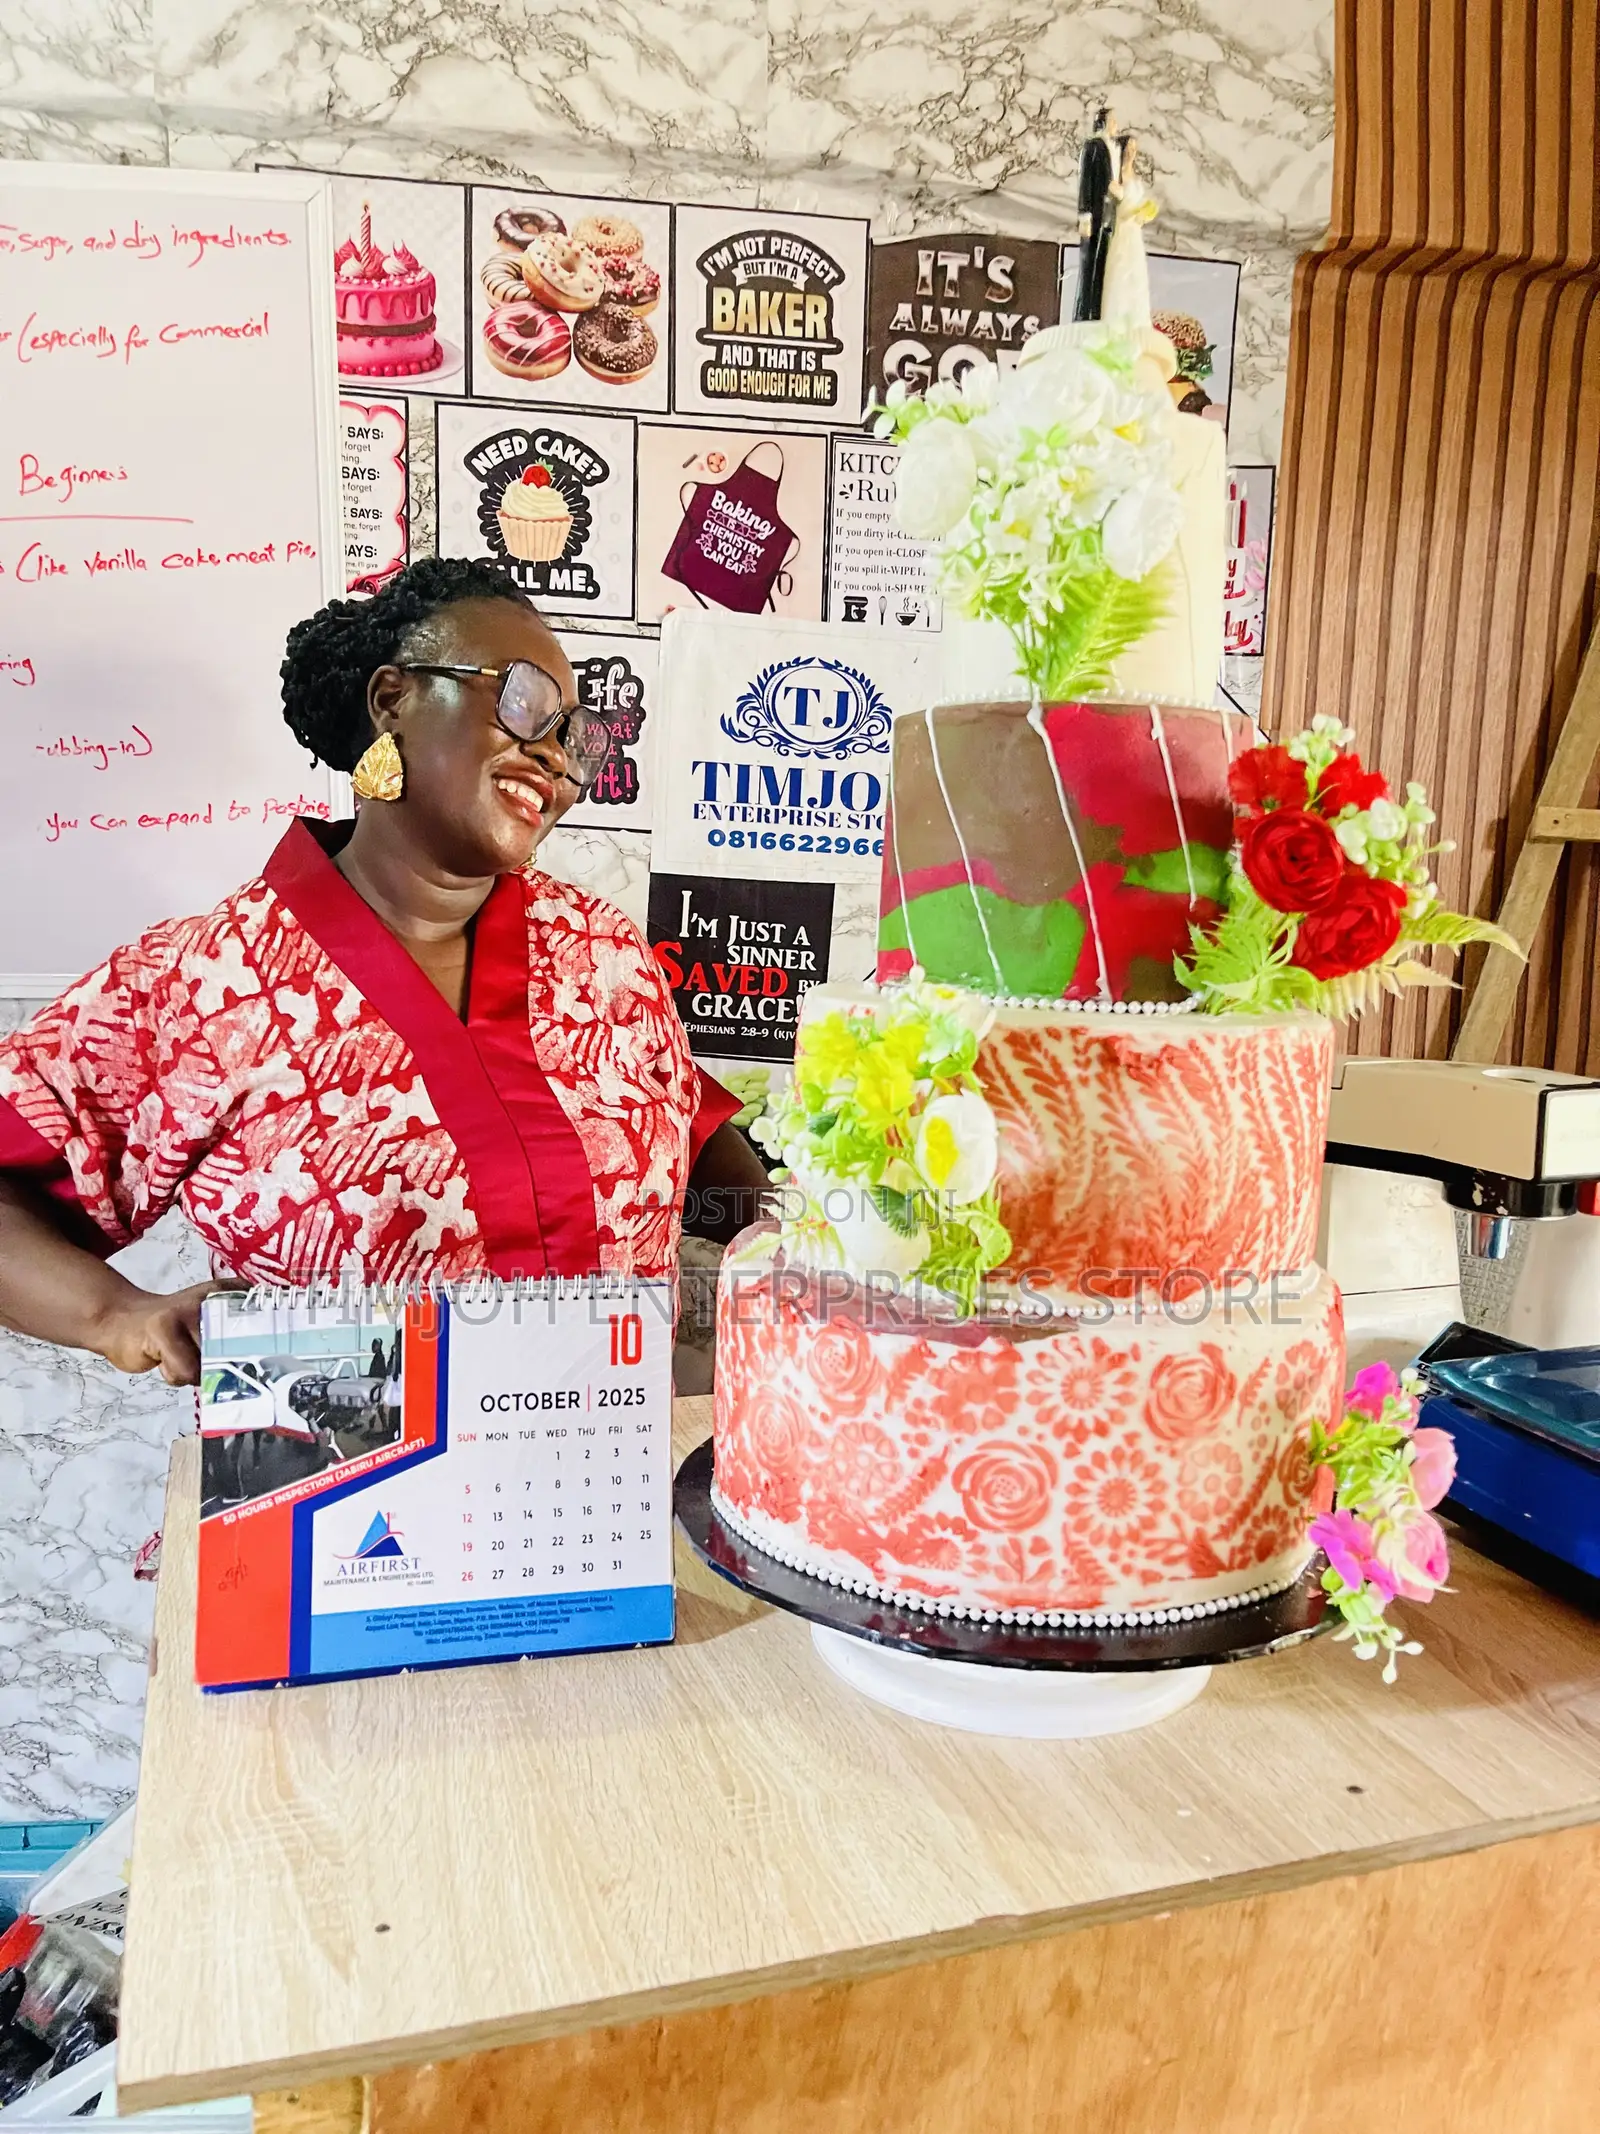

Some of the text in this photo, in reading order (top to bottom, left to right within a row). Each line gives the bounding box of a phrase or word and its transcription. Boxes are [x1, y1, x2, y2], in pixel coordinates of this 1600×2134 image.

[703, 236, 840, 285] I'M NOT PERFECT
[743, 261, 799, 281] BUT I'M A
[915, 245, 1016, 304] IT'S
[712, 286, 828, 340] BAKER
[888, 302, 1041, 342] ALWAYS
[124, 324, 150, 365] for
[721, 344, 817, 372] AND THAT IS
[706, 367, 832, 400] GOOD ENOUGH FOR ME
[347, 426, 384, 440] SAYS:
[470, 434, 603, 481] NEED CAKE?
[341, 465, 381, 481] SAYS:
[350, 507, 383, 520] SAYS:
[710, 489, 777, 541] Baking
[727, 520, 737, 531] IS
[835, 507, 892, 523] If you empty
[702, 519, 766, 559] CHEMISTRY
[835, 526, 844, 536] If
[845, 528, 862, 540] you
[863, 527, 885, 541] dirty
[703, 547, 746, 575] CAN EAT
[716, 540, 743, 562] YOU
[834, 544, 843, 554] If
[845, 546, 861, 558] you
[863, 548, 884, 558] open
[548, 567, 595, 594] ME.
[833, 562, 842, 572] If
[844, 564, 860, 575] you
[862, 564, 880, 576] spill
[833, 580, 841, 590] If
[844, 581, 860, 593] you
[861, 582, 882, 592] cook
[783, 686, 853, 729] TJ
[692, 803, 842, 829] ENTERPRISE
[792, 925, 811, 946] A
[726, 944, 818, 972] SINNER
[691, 992, 804, 1025] GRACE!
[608, 1313, 644, 1367] 10
[480, 1387, 646, 1413] OCTOBER 2025
[457, 1424, 653, 1443] SUN MON TUE WED THU FRI SAT
[222, 1437, 426, 1526] 50 HOURS INSPECTION (JABIRU AIRCRAFT)
[611, 1475, 622, 1486] 10
[641, 1473, 650, 1484] 11
[462, 1501, 651, 1524] 12 13 14 15 16 17 18
[462, 1529, 652, 1553] 19 20 21 22 23 24 25
[323, 1576, 370, 1587] MAINTENANCE
[378, 1572, 421, 1581] ENGINEERING
[336, 1557, 421, 1577] AIRFIRST
[461, 1559, 622, 1582] 26 27 28 29 30 31
